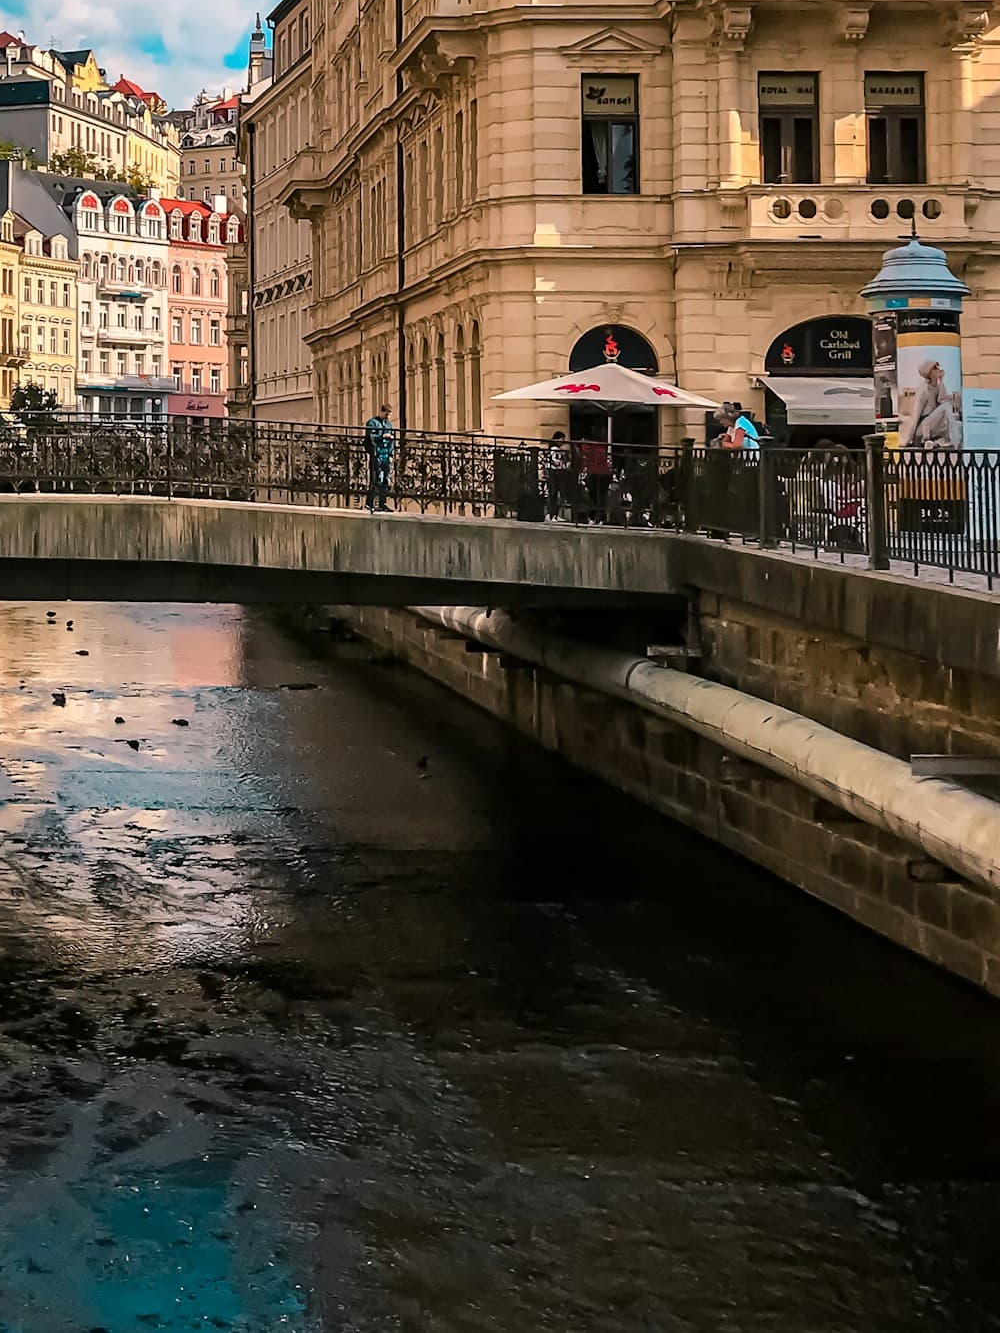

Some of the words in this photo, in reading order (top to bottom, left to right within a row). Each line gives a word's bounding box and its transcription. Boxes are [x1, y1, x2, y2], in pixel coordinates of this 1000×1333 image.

[870, 87, 915, 95] MASSAGE
[830, 330, 848, 339] Old
[820, 340, 861, 349] Carlsbad
[828, 350, 852, 359] Grill
